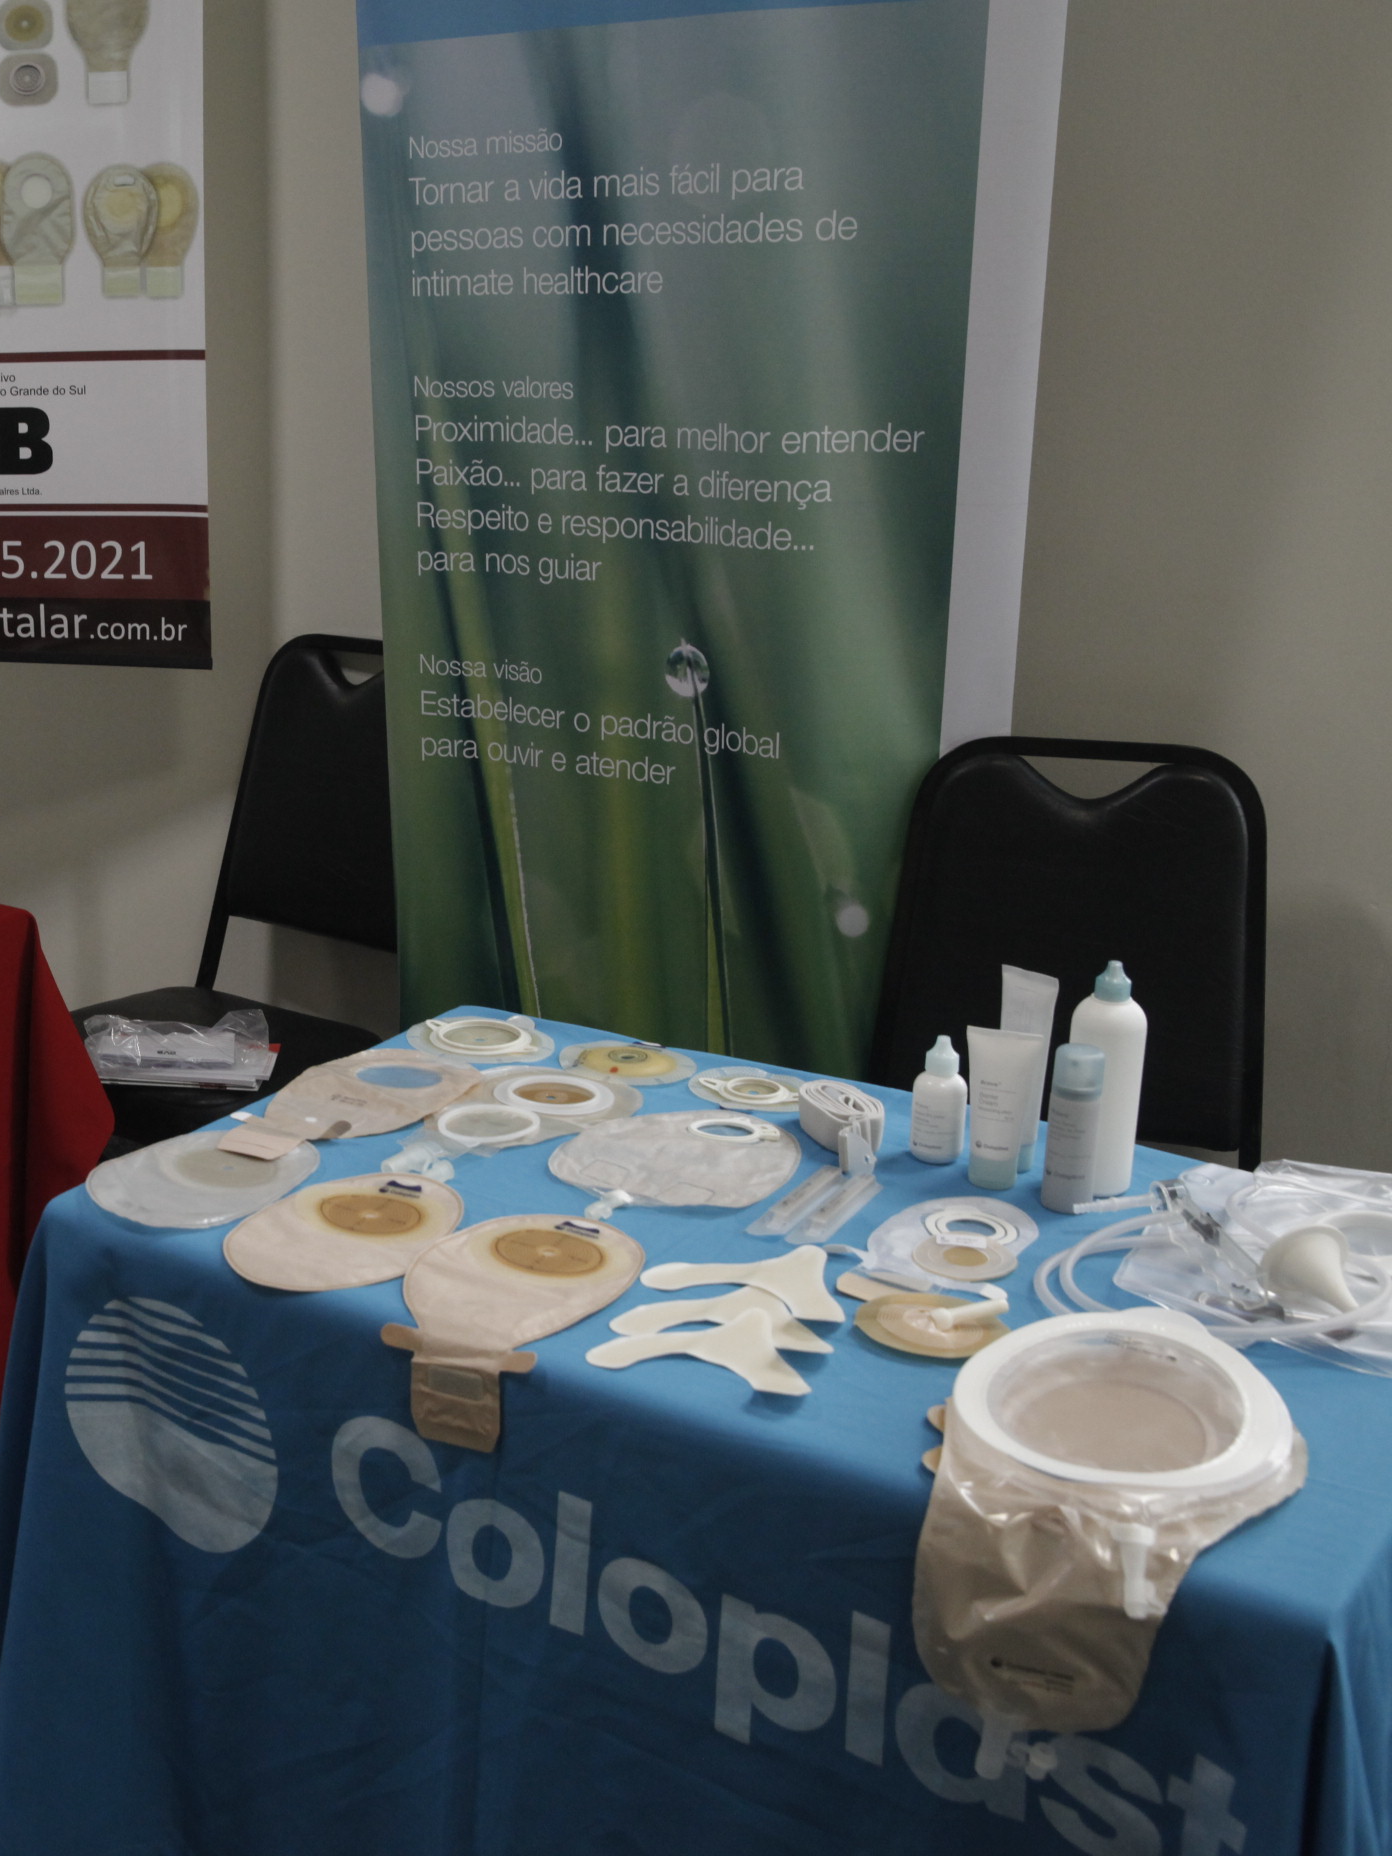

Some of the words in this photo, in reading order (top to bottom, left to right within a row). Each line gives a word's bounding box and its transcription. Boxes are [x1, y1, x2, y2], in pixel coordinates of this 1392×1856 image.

[409, 134, 477, 160] Nossa
[485, 128, 563, 154] missão
[409, 176, 494, 206] Tornar
[504, 179, 520, 201] a
[530, 169, 583, 200] vida
[593, 168, 660, 199] mais
[669, 163, 720, 195] fácil
[731, 164, 804, 199] para
[411, 221, 523, 258] pessoas
[533, 223, 591, 249] com
[603, 212, 804, 246] necessidades
[815, 210, 858, 241] de
[412, 267, 514, 297] intimate
[523, 266, 664, 296] healthcare
[10, 386, 49, 396] Grande
[52, 385, 66, 395] do
[69, 384, 86, 395] Sul
[413, 376, 495, 399] Nossos
[503, 375, 574, 400] valores
[415, 415, 593, 447] Proximidade...
[606, 423, 666, 450] para
[677, 422, 770, 454] melhor
[781, 423, 924, 453] entender
[415, 458, 520, 488] Paixão...
[531, 468, 587, 493] para
[597, 464, 663, 495] fazer
[673, 478, 690, 497] a
[699, 470, 832, 510] diferença
[416, 501, 529, 537] Respeito
[537, 513, 552, 533] e
[561, 513, 815, 551] responsabilidade...
[417, 550, 475, 576] para
[484, 554, 530, 575] nos
[539, 553, 602, 584] guiar
[419, 654, 487, 678] Nossa
[493, 659, 542, 685] visão
[420, 690, 565, 731] Estabelecer
[574, 712, 590, 732] o
[600, 711, 694, 747] padrão
[704, 722, 780, 760] global
[421, 737, 478, 762] para
[488, 740, 542, 769] ouvir
[552, 753, 567, 772] e
[576, 751, 677, 785] atender
[331, 1416, 1248, 1856] Coloplast
